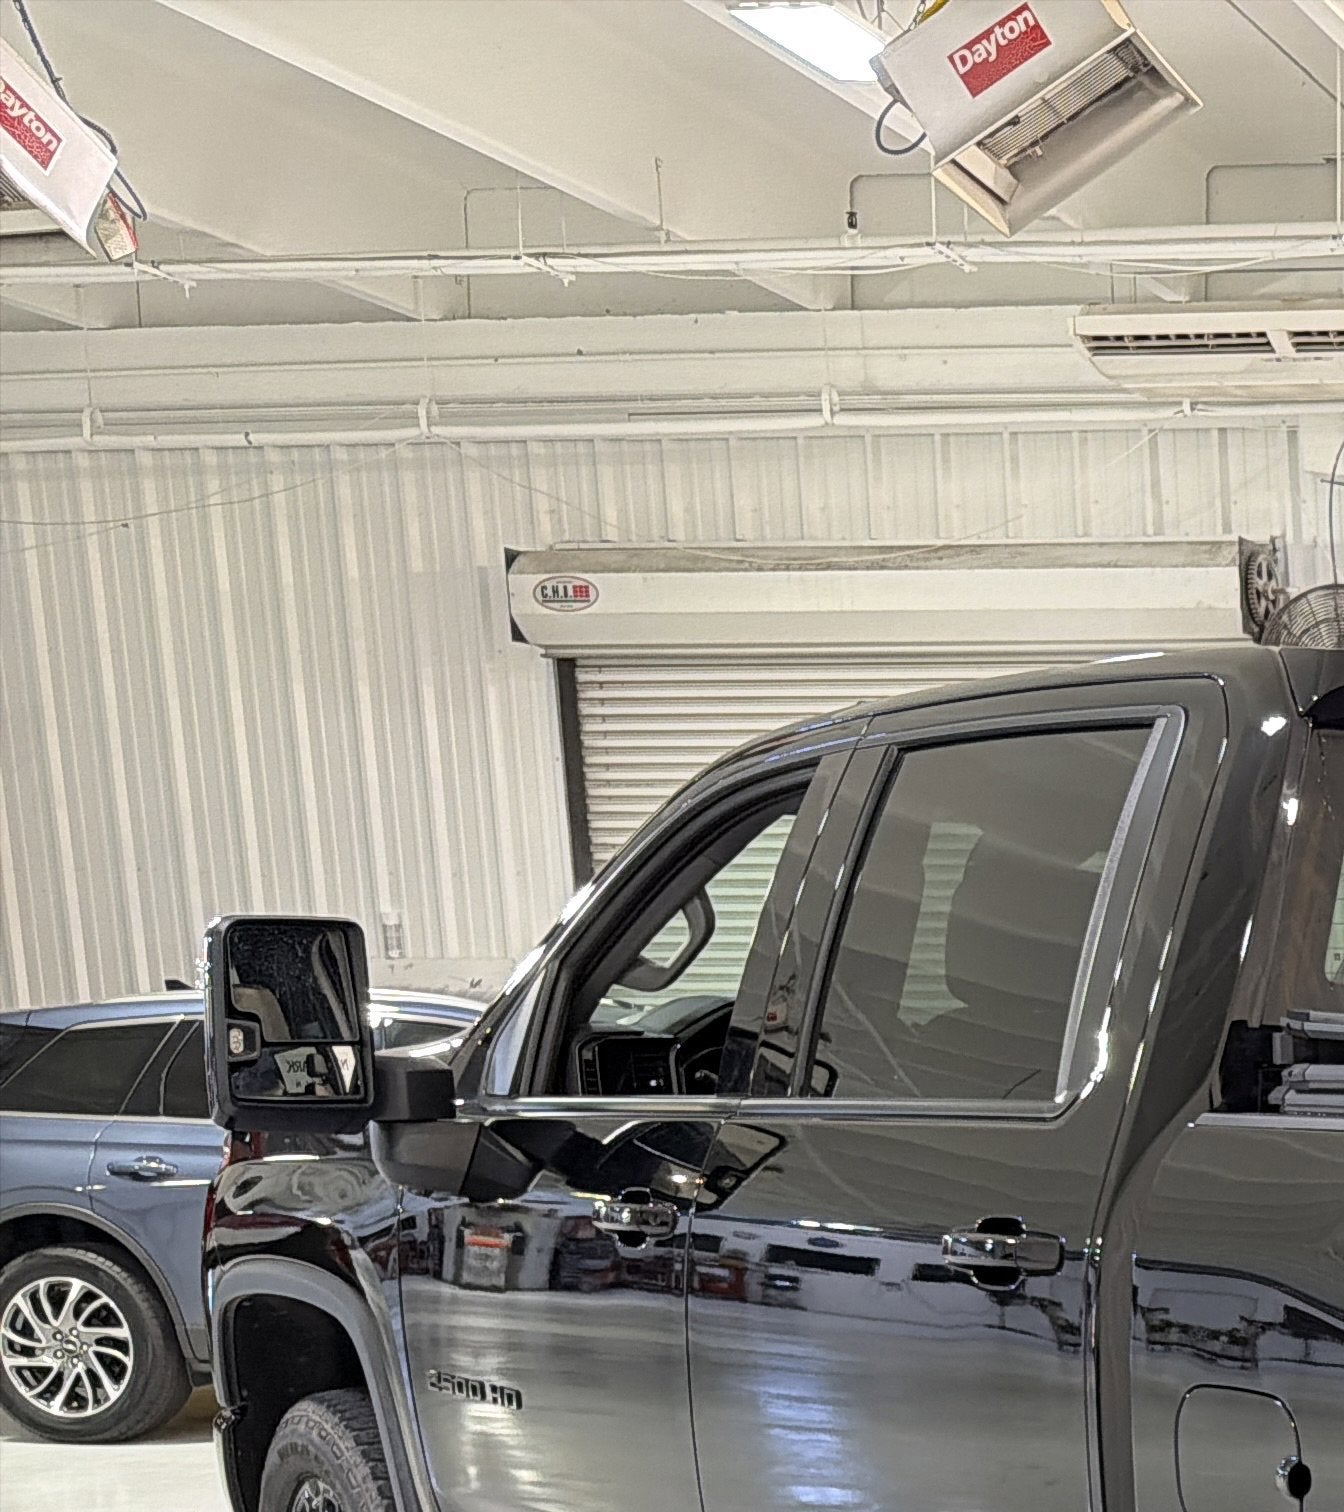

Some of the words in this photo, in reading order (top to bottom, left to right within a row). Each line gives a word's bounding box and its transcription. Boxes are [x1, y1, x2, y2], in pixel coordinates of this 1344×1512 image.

[953, 9, 1036, 75] Dayton
[0, 79, 59, 148] ayton
[489, 1381, 523, 1410] HD
